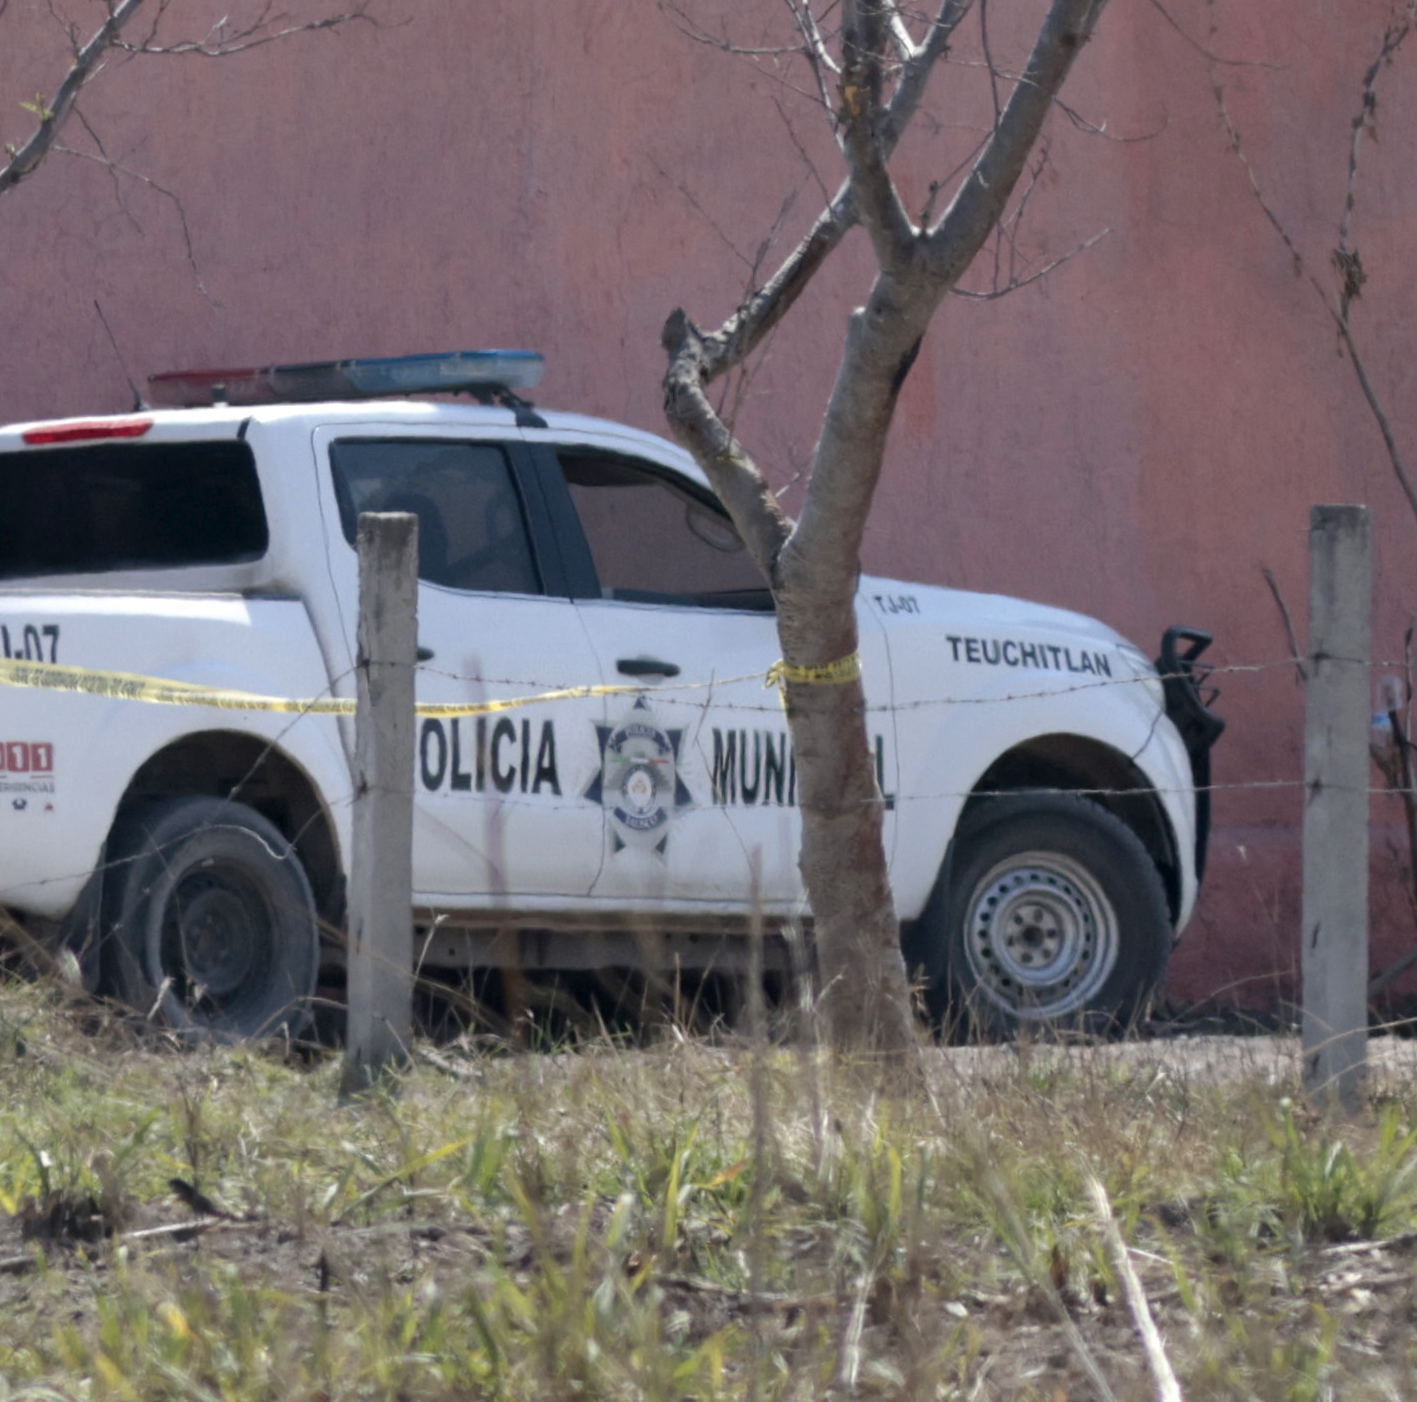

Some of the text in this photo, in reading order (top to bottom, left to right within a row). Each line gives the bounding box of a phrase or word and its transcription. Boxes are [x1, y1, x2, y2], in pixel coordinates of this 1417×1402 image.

[946, 634, 1113, 678] TEUCHITLAN
[419, 716, 895, 811] OLICIA MUNIL
